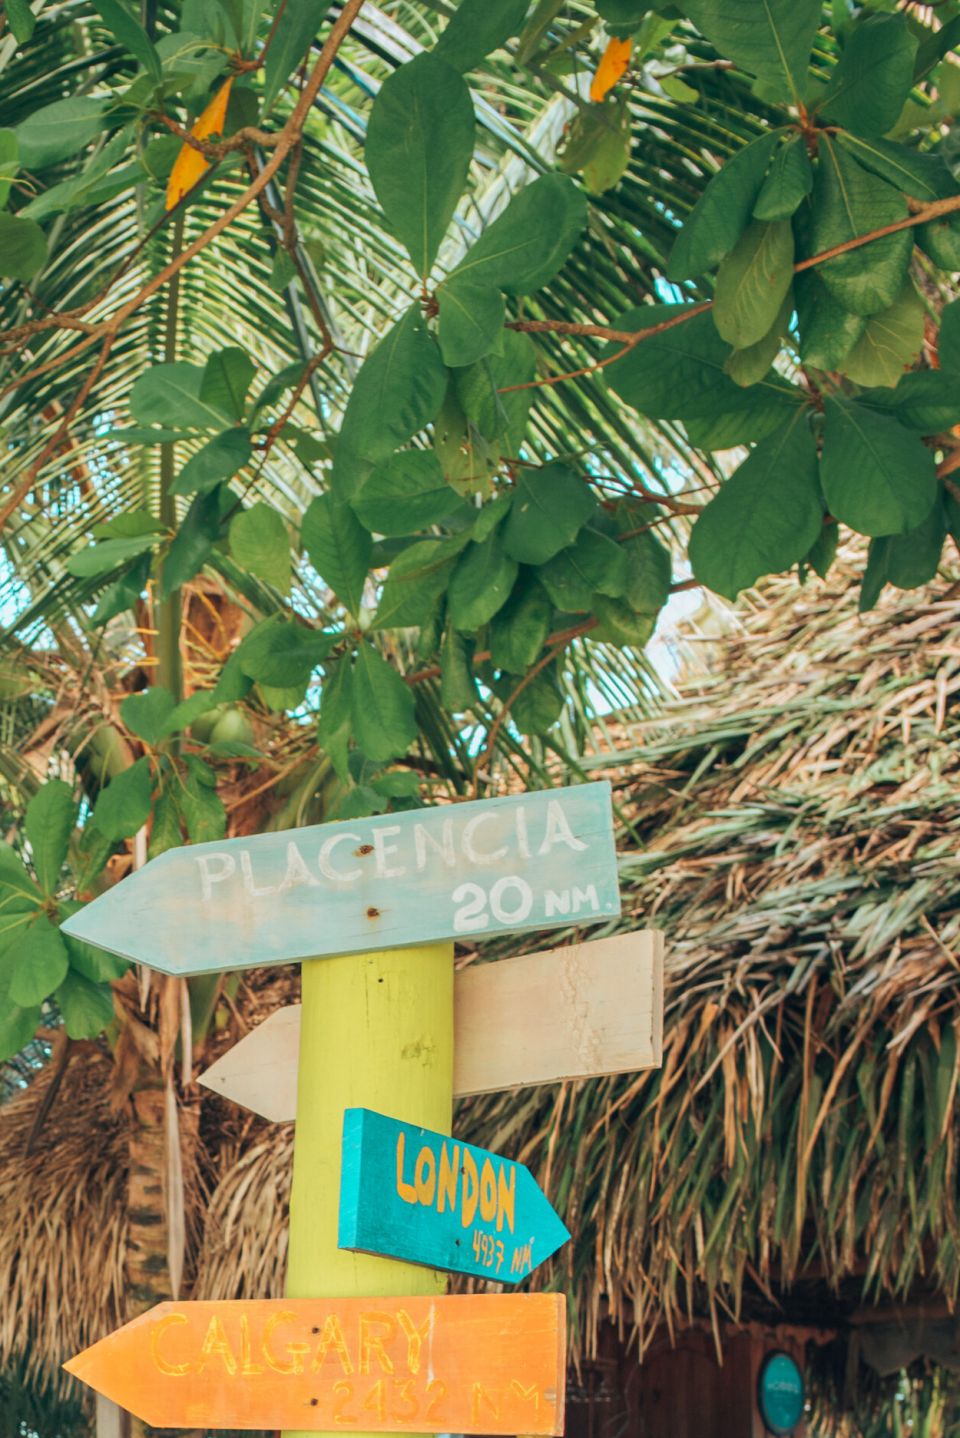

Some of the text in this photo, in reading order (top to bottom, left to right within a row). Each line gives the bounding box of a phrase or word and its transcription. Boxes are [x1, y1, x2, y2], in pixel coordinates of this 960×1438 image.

[195, 800, 589, 900] PLACENCIA
[452, 875, 534, 932] 20
[396, 1131, 516, 1234] LONDON
[472, 1229, 505, 1274] 4937
[150, 1308, 438, 1377] CALGARY
[332, 1378, 448, 1425] 2432
